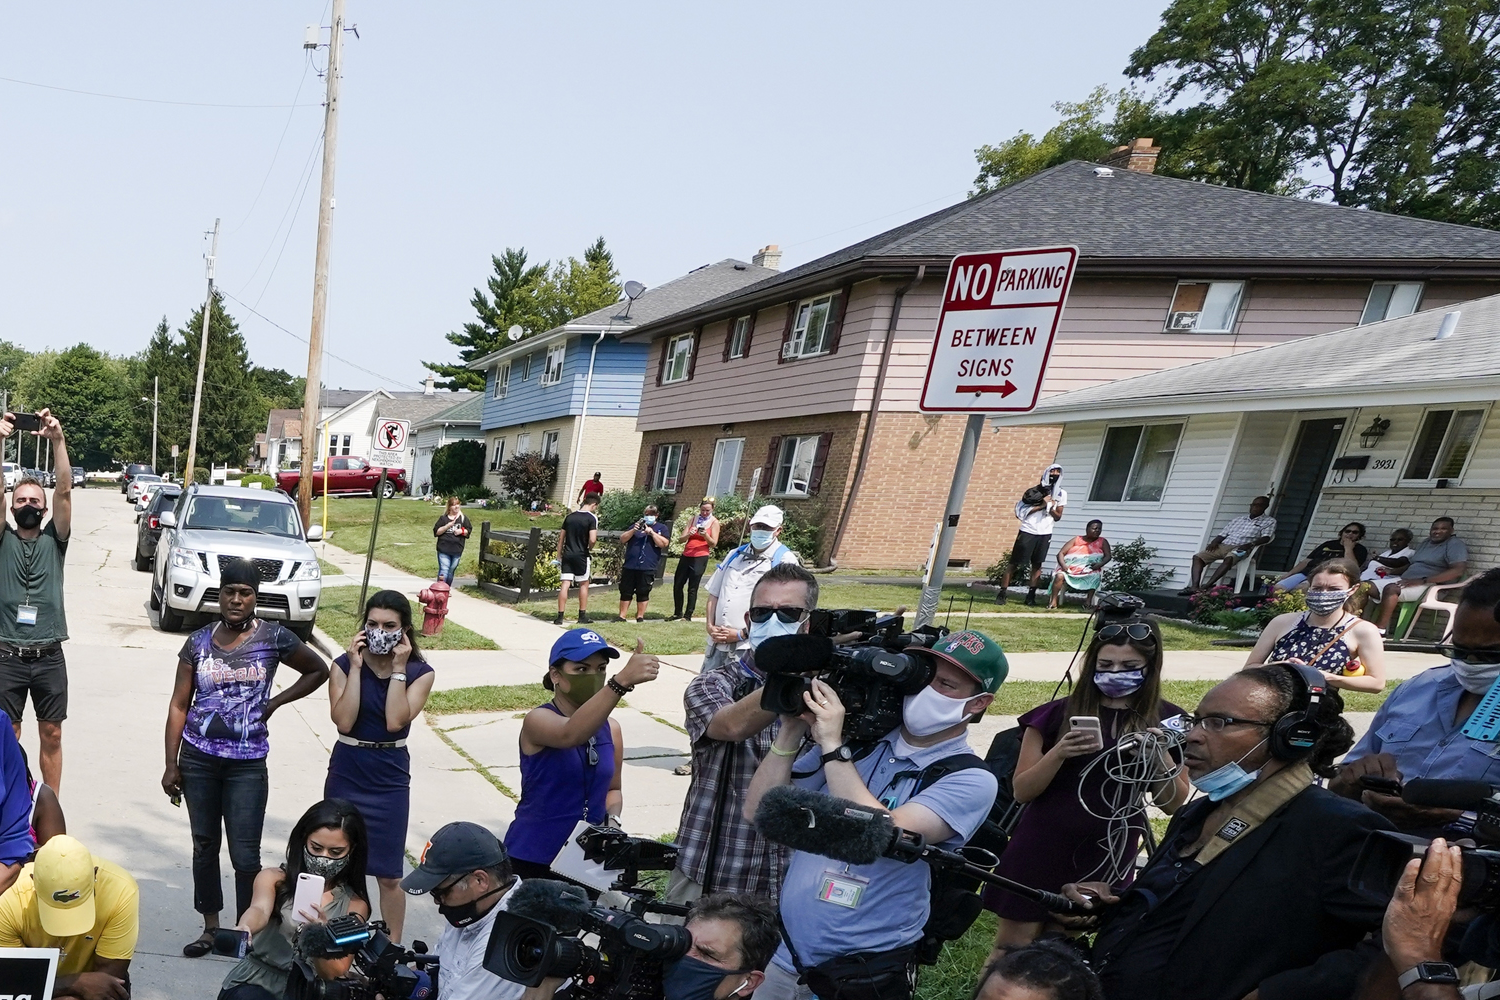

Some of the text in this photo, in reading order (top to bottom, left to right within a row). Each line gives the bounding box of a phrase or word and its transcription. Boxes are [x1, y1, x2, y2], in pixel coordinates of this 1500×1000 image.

[950, 263, 1066, 302] NO PARKING
[950, 327, 1038, 348] BETWEEN
[957, 358, 1014, 377] SIGNS
[1372, 459, 1397, 470] 3931
[211, 667, 267, 683] VEGAS
